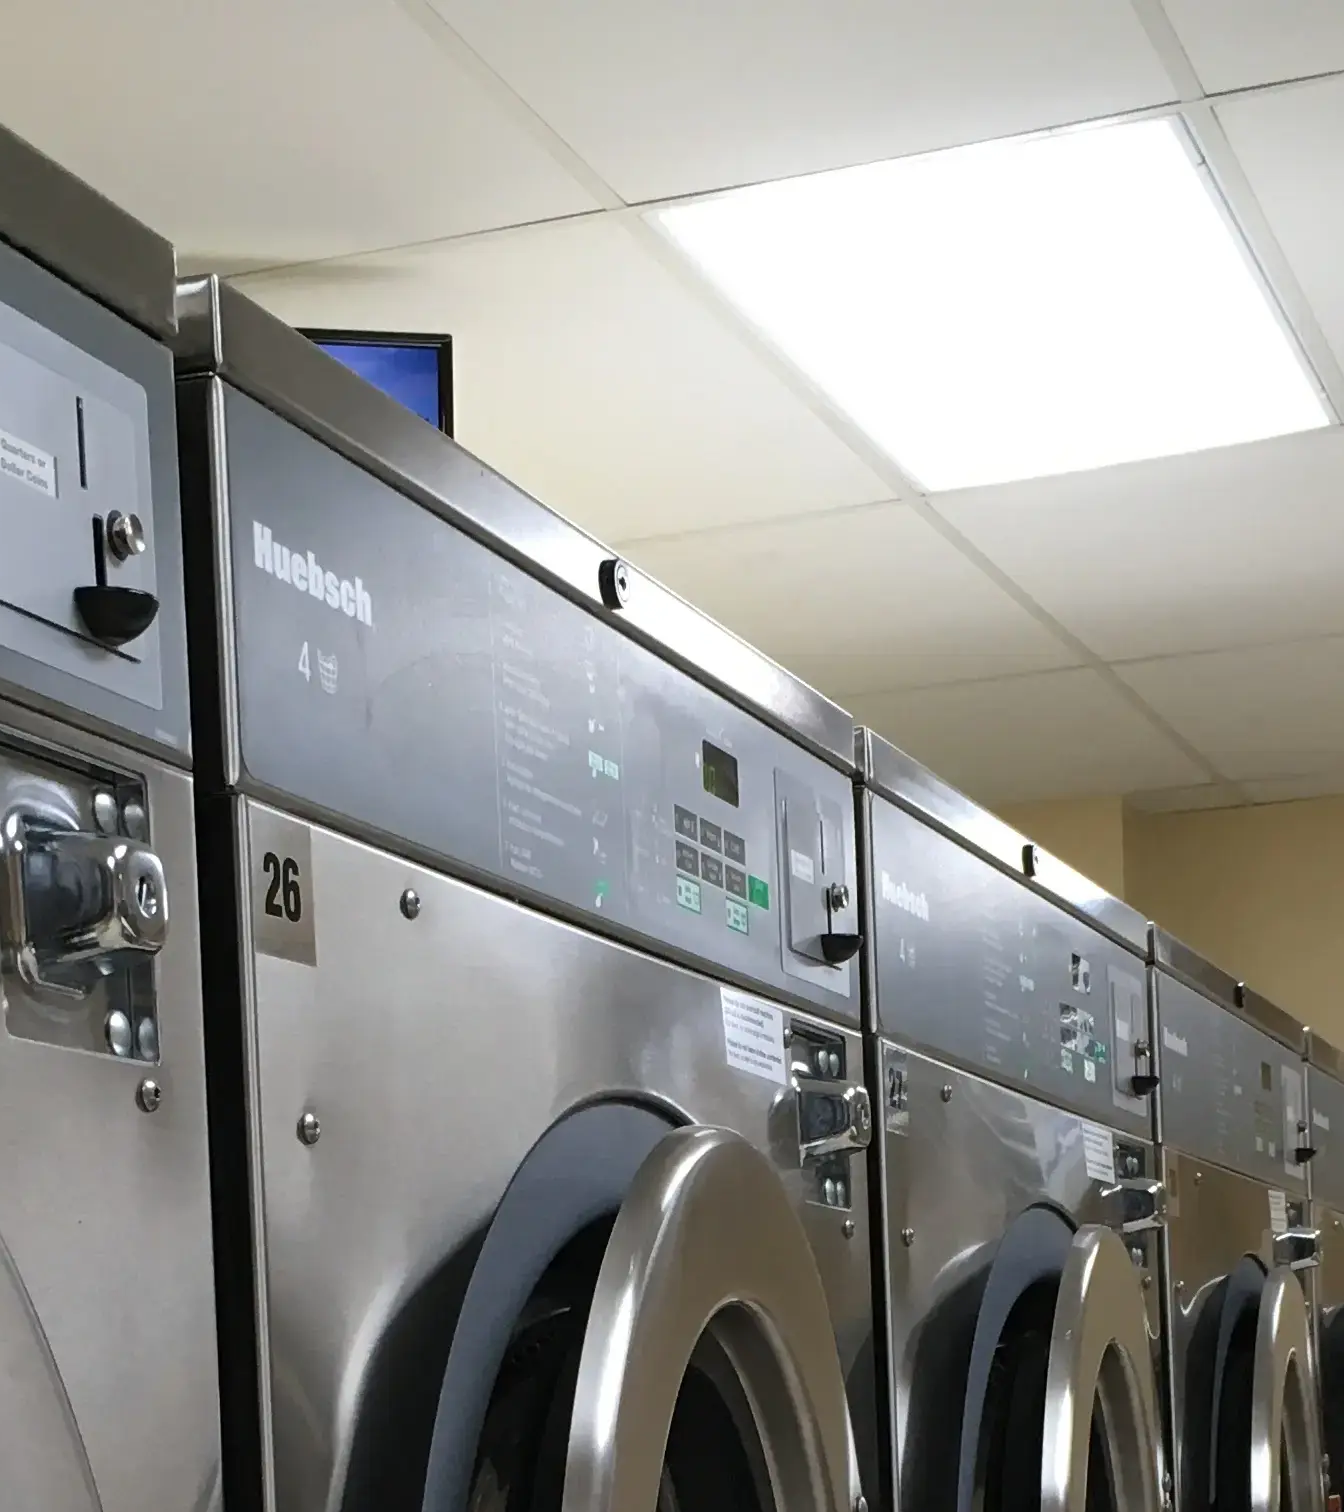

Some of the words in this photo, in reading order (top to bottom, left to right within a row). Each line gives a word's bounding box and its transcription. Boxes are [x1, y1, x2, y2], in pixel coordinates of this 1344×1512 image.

[253, 520, 373, 627] Huebsch
[298, 641, 311, 682] 4
[263, 852, 302, 922] 26
